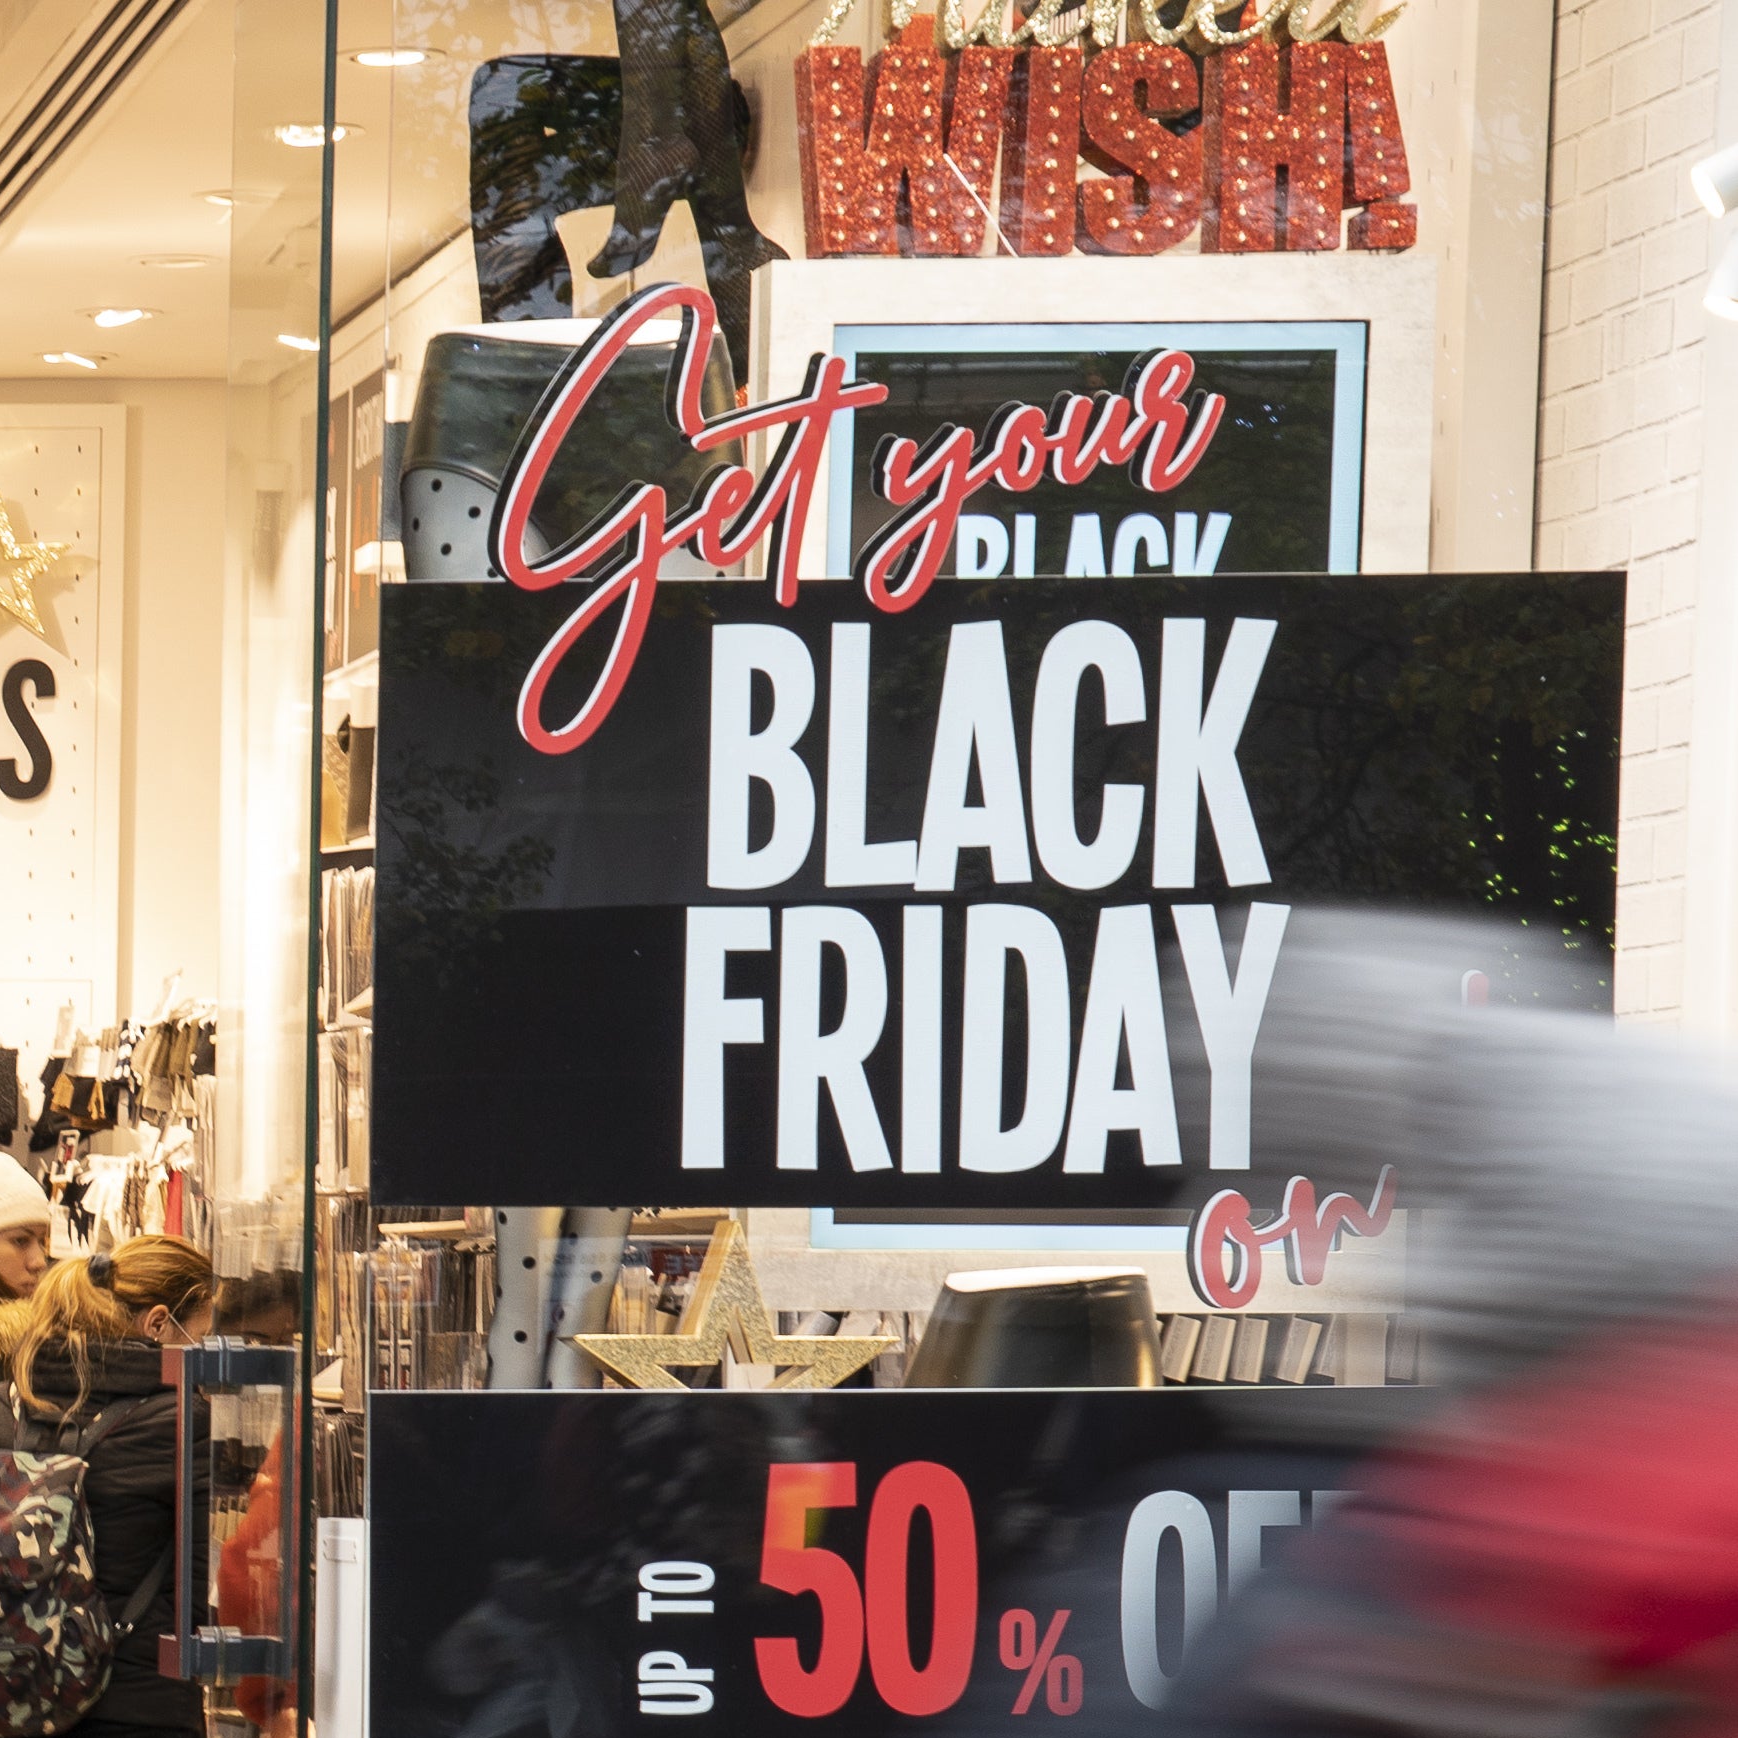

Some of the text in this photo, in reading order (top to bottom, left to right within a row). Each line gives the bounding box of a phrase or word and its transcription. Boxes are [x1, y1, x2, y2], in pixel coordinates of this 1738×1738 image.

[794, 40, 1420, 258] WISH!
[488, 281, 1226, 755] Get your
[707, 616, 1279, 893] BLACK
[681, 902, 1292, 1175] FRIDAY
[637, 1560, 714, 1622] TO
[637, 1650, 714, 1716] UP
[1121, 1490, 1366, 1712] OF
